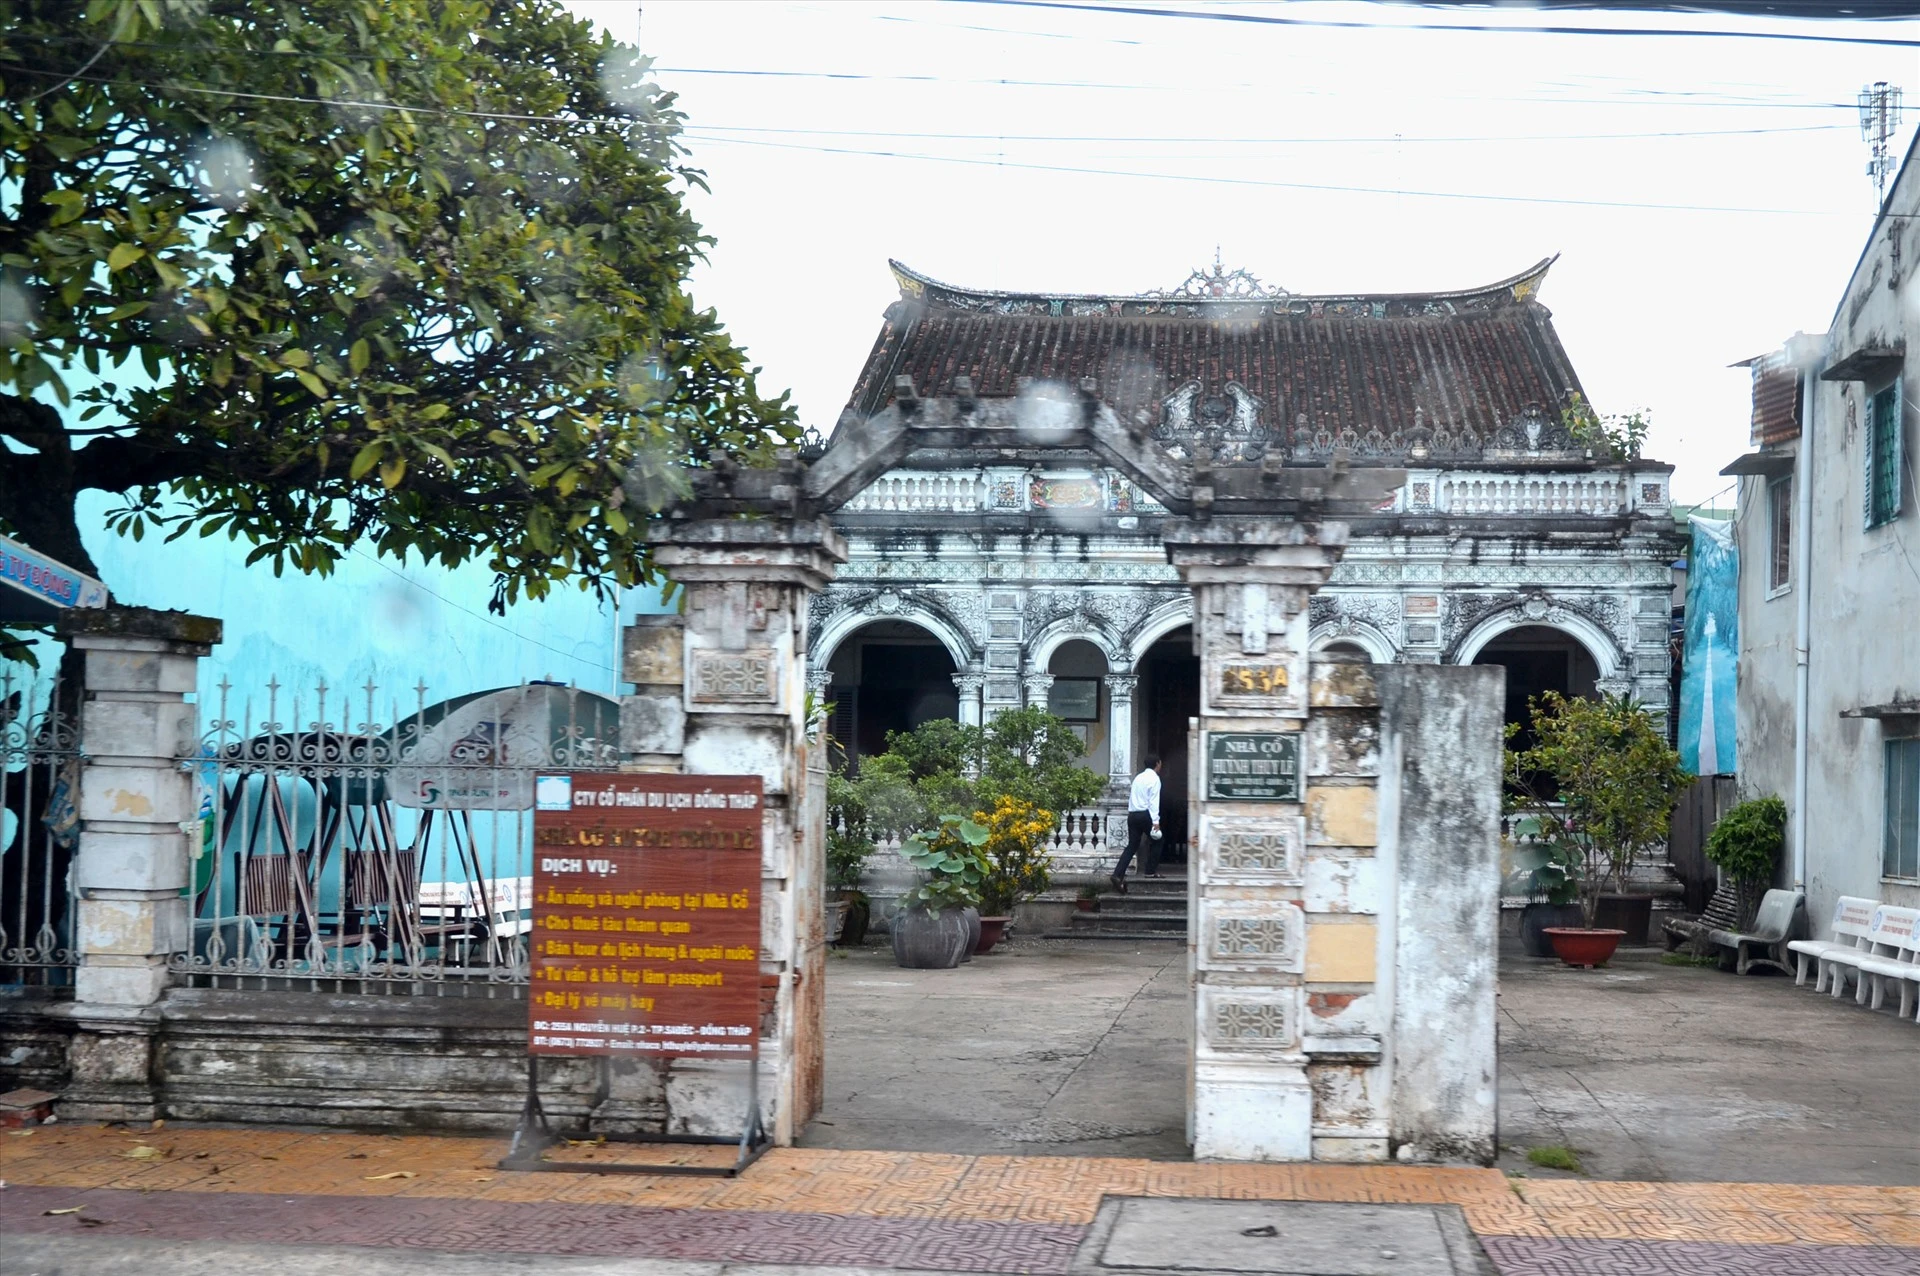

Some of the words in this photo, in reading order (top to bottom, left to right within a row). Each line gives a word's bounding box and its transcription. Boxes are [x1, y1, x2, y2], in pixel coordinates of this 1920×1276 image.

[1225, 739, 1258, 753] NHÀ
[574, 791, 597, 806] CTY
[598, 784, 615, 807] CỔ
[648, 792, 665, 807] DU
[666, 792, 692, 812] LỊCH
[728, 790, 758, 809] THÁP
[542, 859, 582, 877] DỊCH
[586, 860, 617, 877] VỤ:
[547, 886, 564, 904] Ăn
[565, 887, 596, 908] uống
[597, 890, 613, 906] và
[615, 889, 642, 909] nghỉ
[644, 892, 681, 911] phòng
[684, 892, 701, 911] tại
[703, 893, 728, 908] Nhà
[731, 888, 749, 909] Cổ
[546, 915, 570, 930] Cho
[573, 916, 600, 931] thuê
[602, 916, 623, 931] tàu
[626, 917, 657, 932] tham
[660, 921, 690, 936] quan
[546, 940, 571, 955] Bán
[573, 941, 598, 956] tour
[601, 942, 617, 957] du
[619, 942, 641, 960] lịch
[644, 943, 677, 961] trong
[678, 944, 688, 959] &
[689, 945, 723, 962] ngoài
[725, 944, 755, 960] nước
[545, 966, 562, 981] Tư
[564, 964, 587, 982] vấn
[590, 968, 600, 983] &
[602, 964, 618, 983] hỗ
[621, 968, 640, 987] trợ
[643, 969, 666, 984] làm
[668, 971, 723, 988] passport
[545, 991, 566, 1009] Đại
[568, 991, 581, 1010] lý
[583, 993, 599, 1007] vé
[601, 993, 627, 1011] máy
[630, 993, 655, 1012] bay
